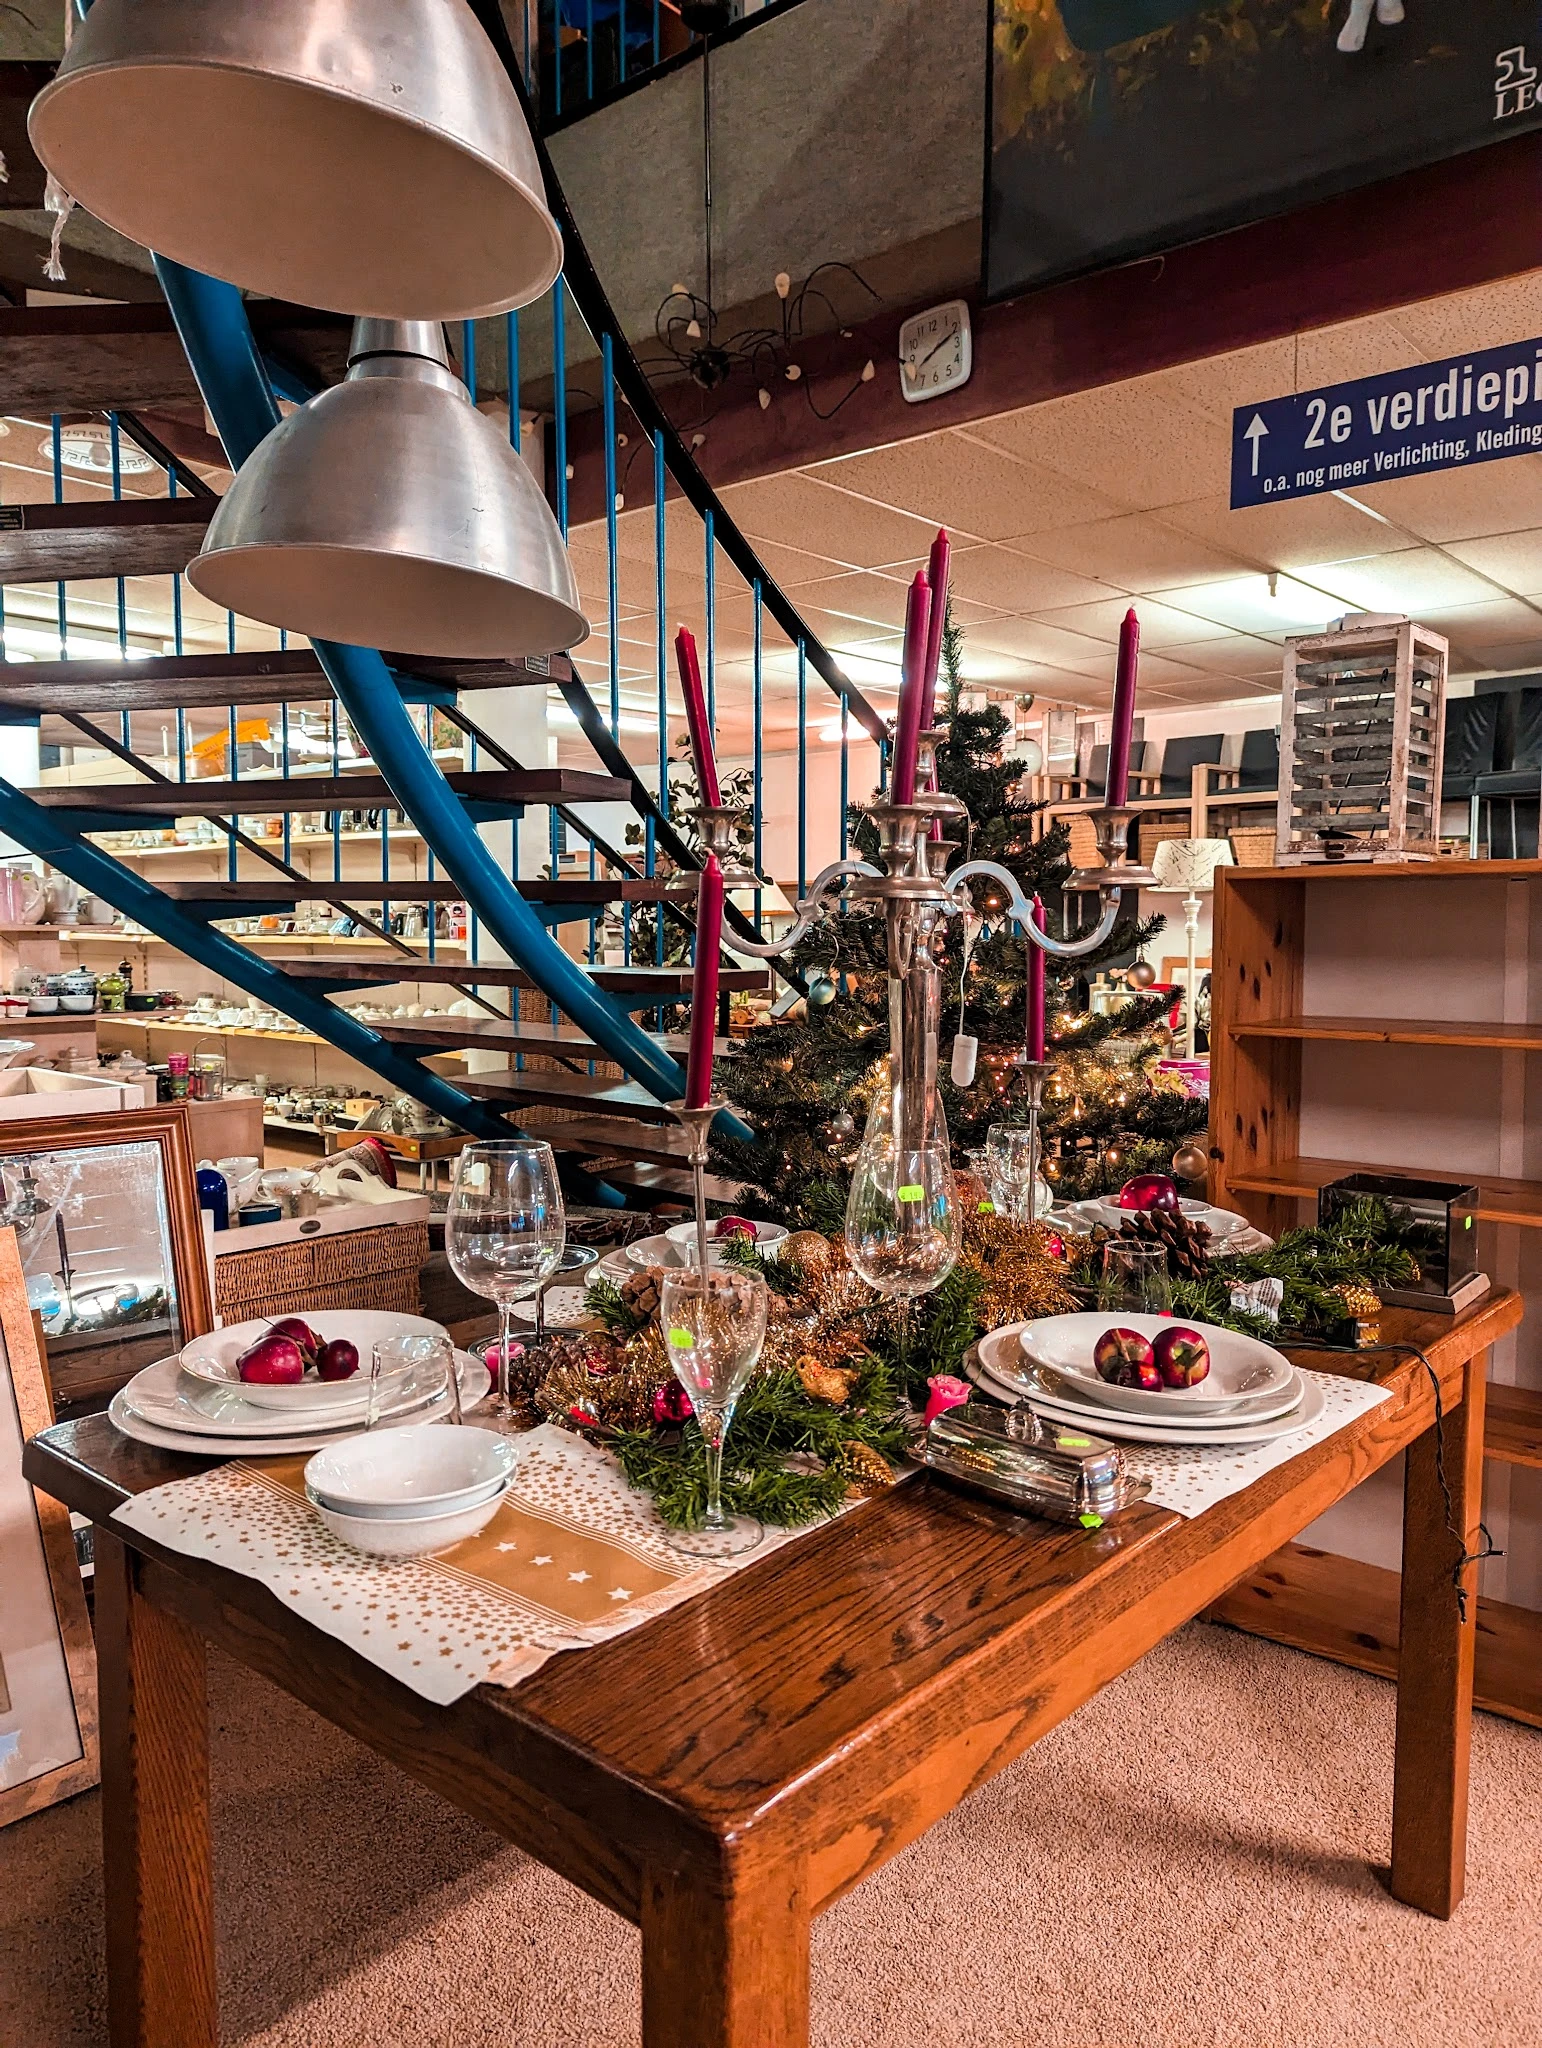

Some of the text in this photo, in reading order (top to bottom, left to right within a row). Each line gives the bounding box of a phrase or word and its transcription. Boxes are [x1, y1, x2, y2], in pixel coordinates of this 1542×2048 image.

[917, 326, 924, 337] 11
[928, 320, 937, 332] 12
[909, 338, 918, 351] 10
[954, 336, 961, 348] 3
[954, 353, 960, 363] 4
[946, 365, 952, 376] 5
[920, 375, 926, 387] 7
[933, 371, 939, 383] 6
[1304, 349, 1542, 449] 2e verdiepi
[1263, 424, 1542, 494] o.a. nog meer Verlichting, Kleding
